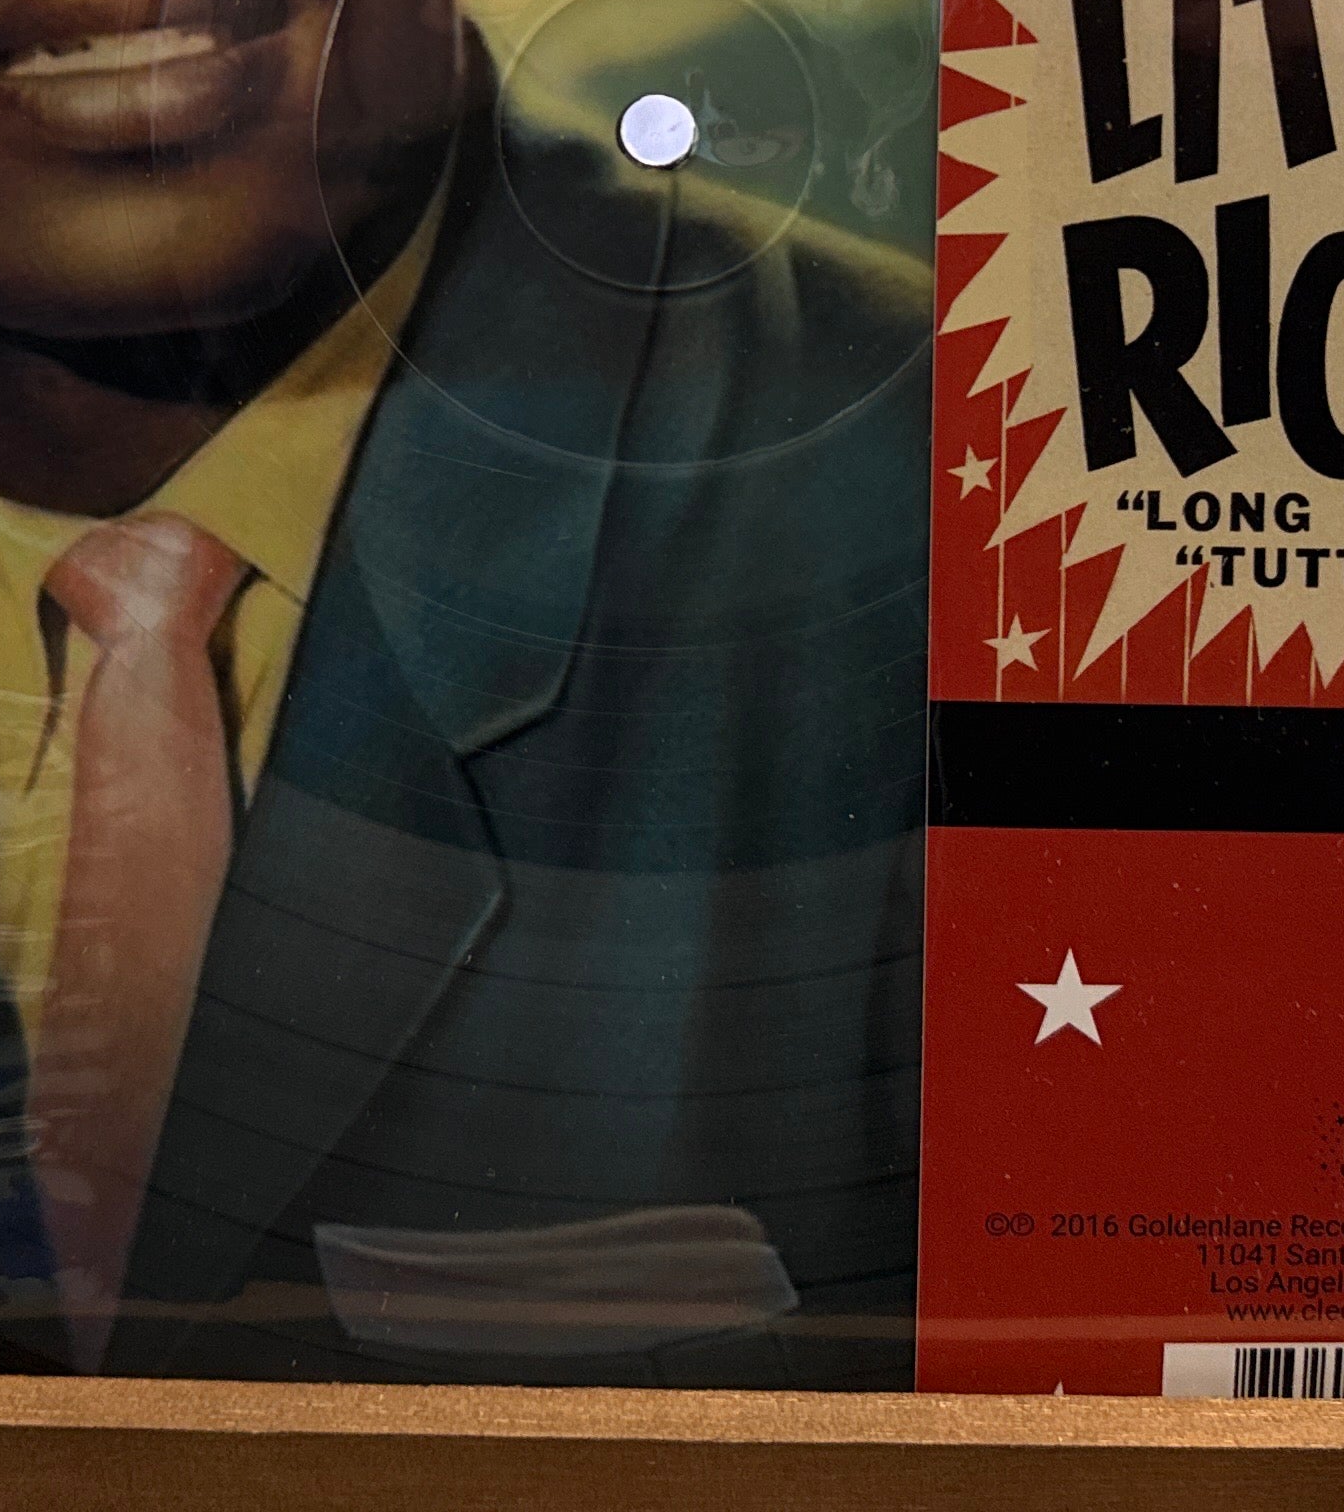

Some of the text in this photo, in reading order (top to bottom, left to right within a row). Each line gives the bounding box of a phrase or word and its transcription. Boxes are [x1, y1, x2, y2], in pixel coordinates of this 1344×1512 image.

[1050, 1213, 1119, 1238] 2016
[1128, 1212, 1282, 1238] Goldenlane
[1198, 1243, 1278, 1267] 11041
[1210, 1271, 1258, 1295] Los
